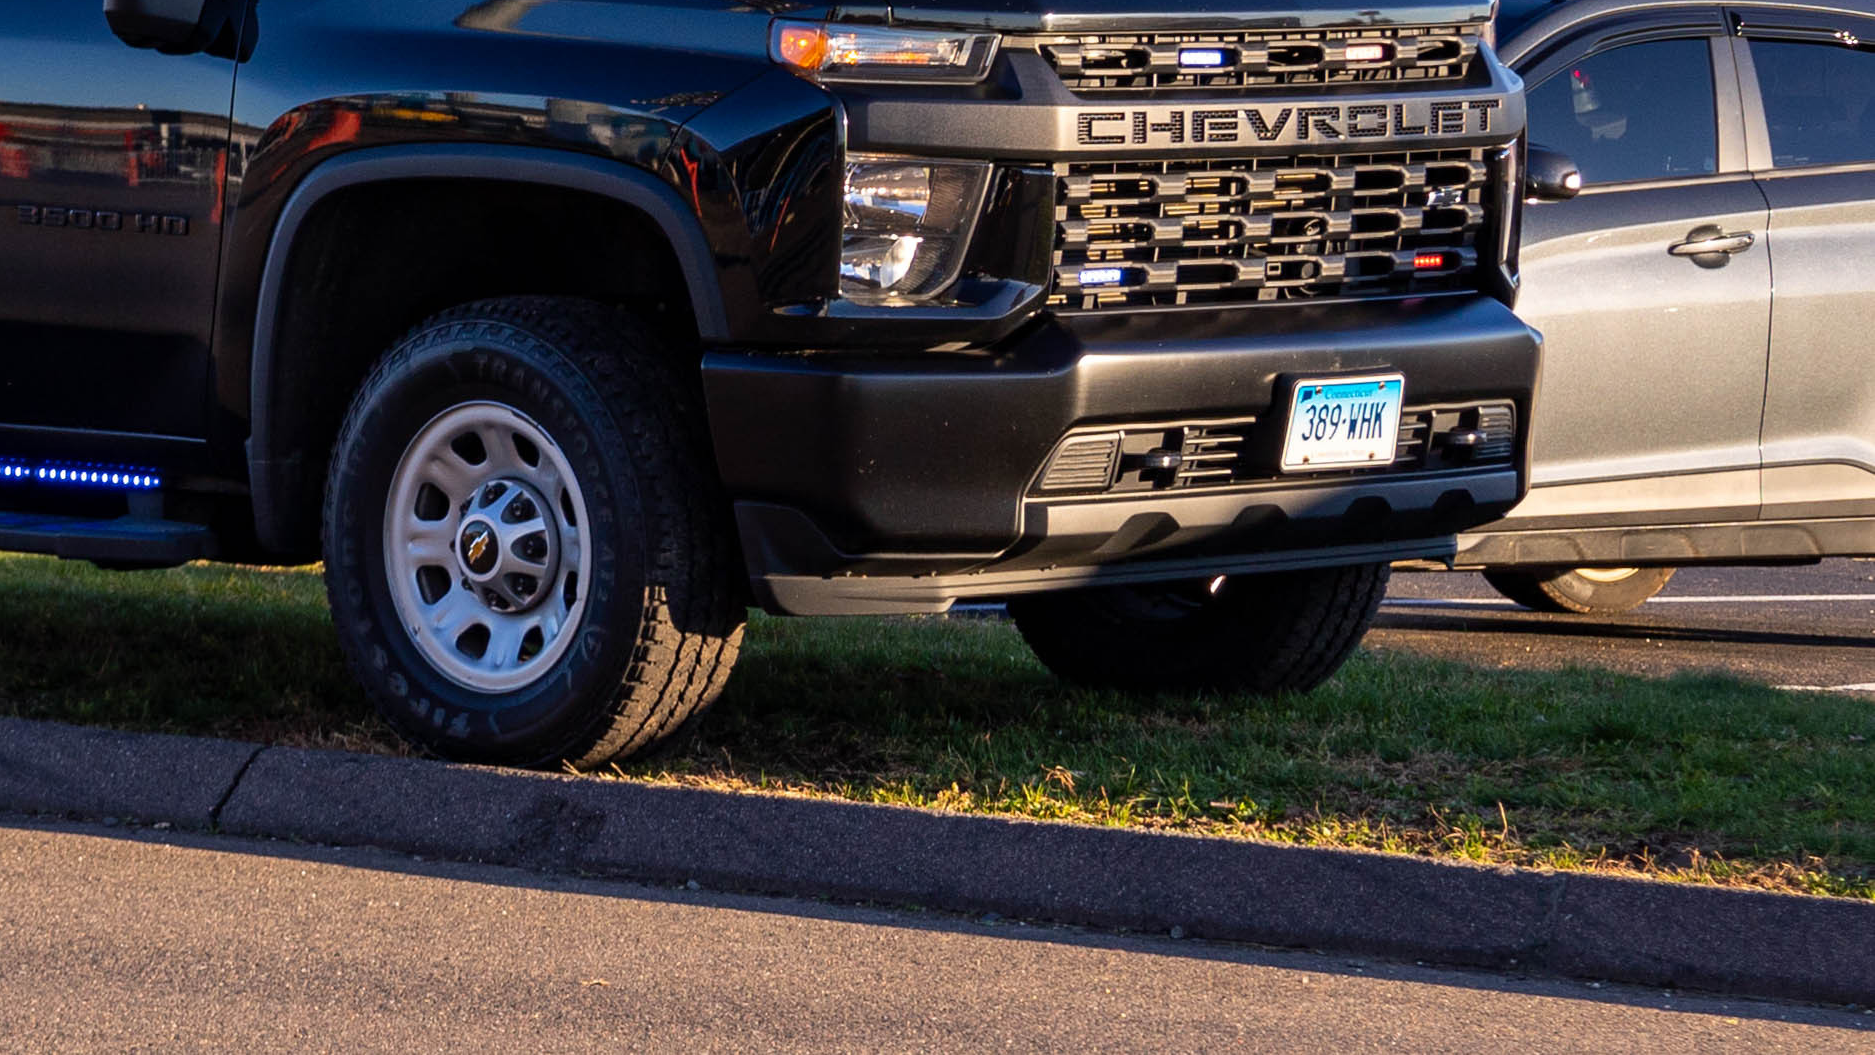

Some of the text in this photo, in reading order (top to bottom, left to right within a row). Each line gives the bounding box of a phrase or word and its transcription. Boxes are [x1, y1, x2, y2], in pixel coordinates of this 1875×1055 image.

[1077, 99, 1503, 145] CHEVROLET
[17, 204, 190, 235] 3500 HD
